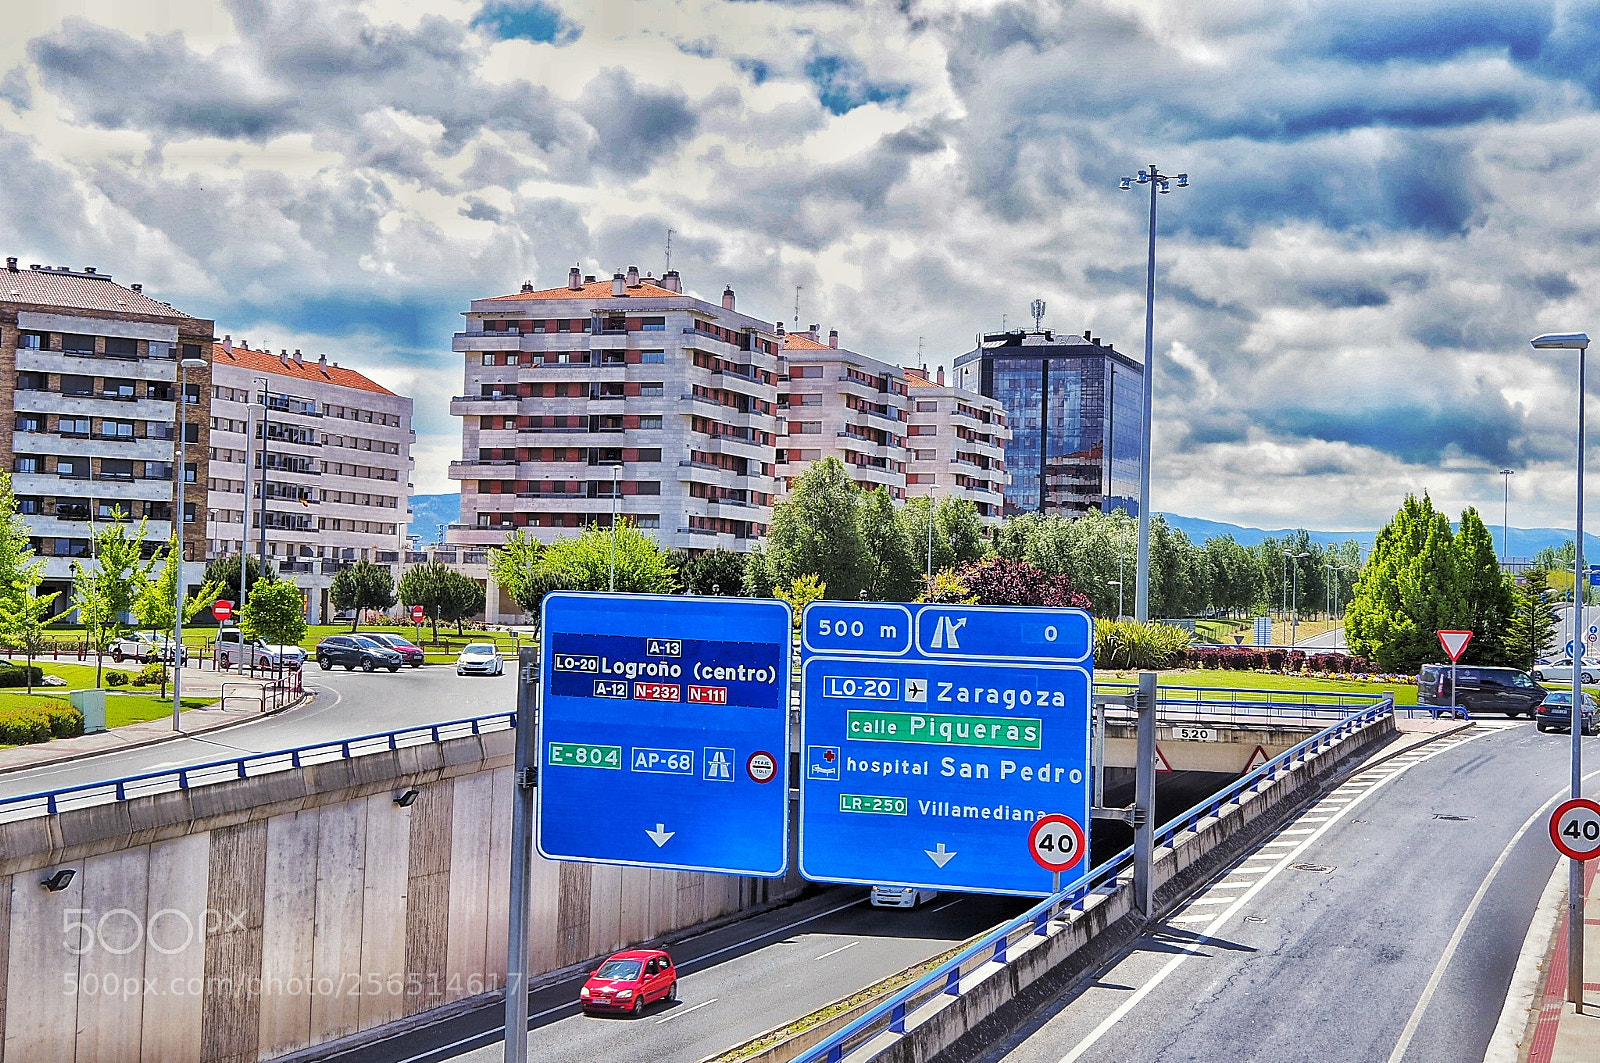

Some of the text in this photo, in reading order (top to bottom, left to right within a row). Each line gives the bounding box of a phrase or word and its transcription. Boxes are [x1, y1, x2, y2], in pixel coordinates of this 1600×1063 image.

[819, 620, 897, 639] 500 m
[650, 641, 680, 655] A-13
[556, 656, 776, 684] LO-20 Logroño (centro)
[596, 682, 625, 696] A-12
[636, 685, 678, 700] N-232
[690, 688, 725, 703] N-111
[831, 679, 1065, 709] LO-20 Zaragoza
[851, 717, 1038, 742] calle Piqueras
[1181, 729, 1208, 739] 5.20
[552, 746, 618, 766] E-804
[634, 754, 691, 771] AP-68
[847, 756, 1083, 784] hospital San Pedro
[842, 797, 905, 812] LR-250
[1563, 820, 1600, 841] 40
[1038, 834, 1074, 853] 40
